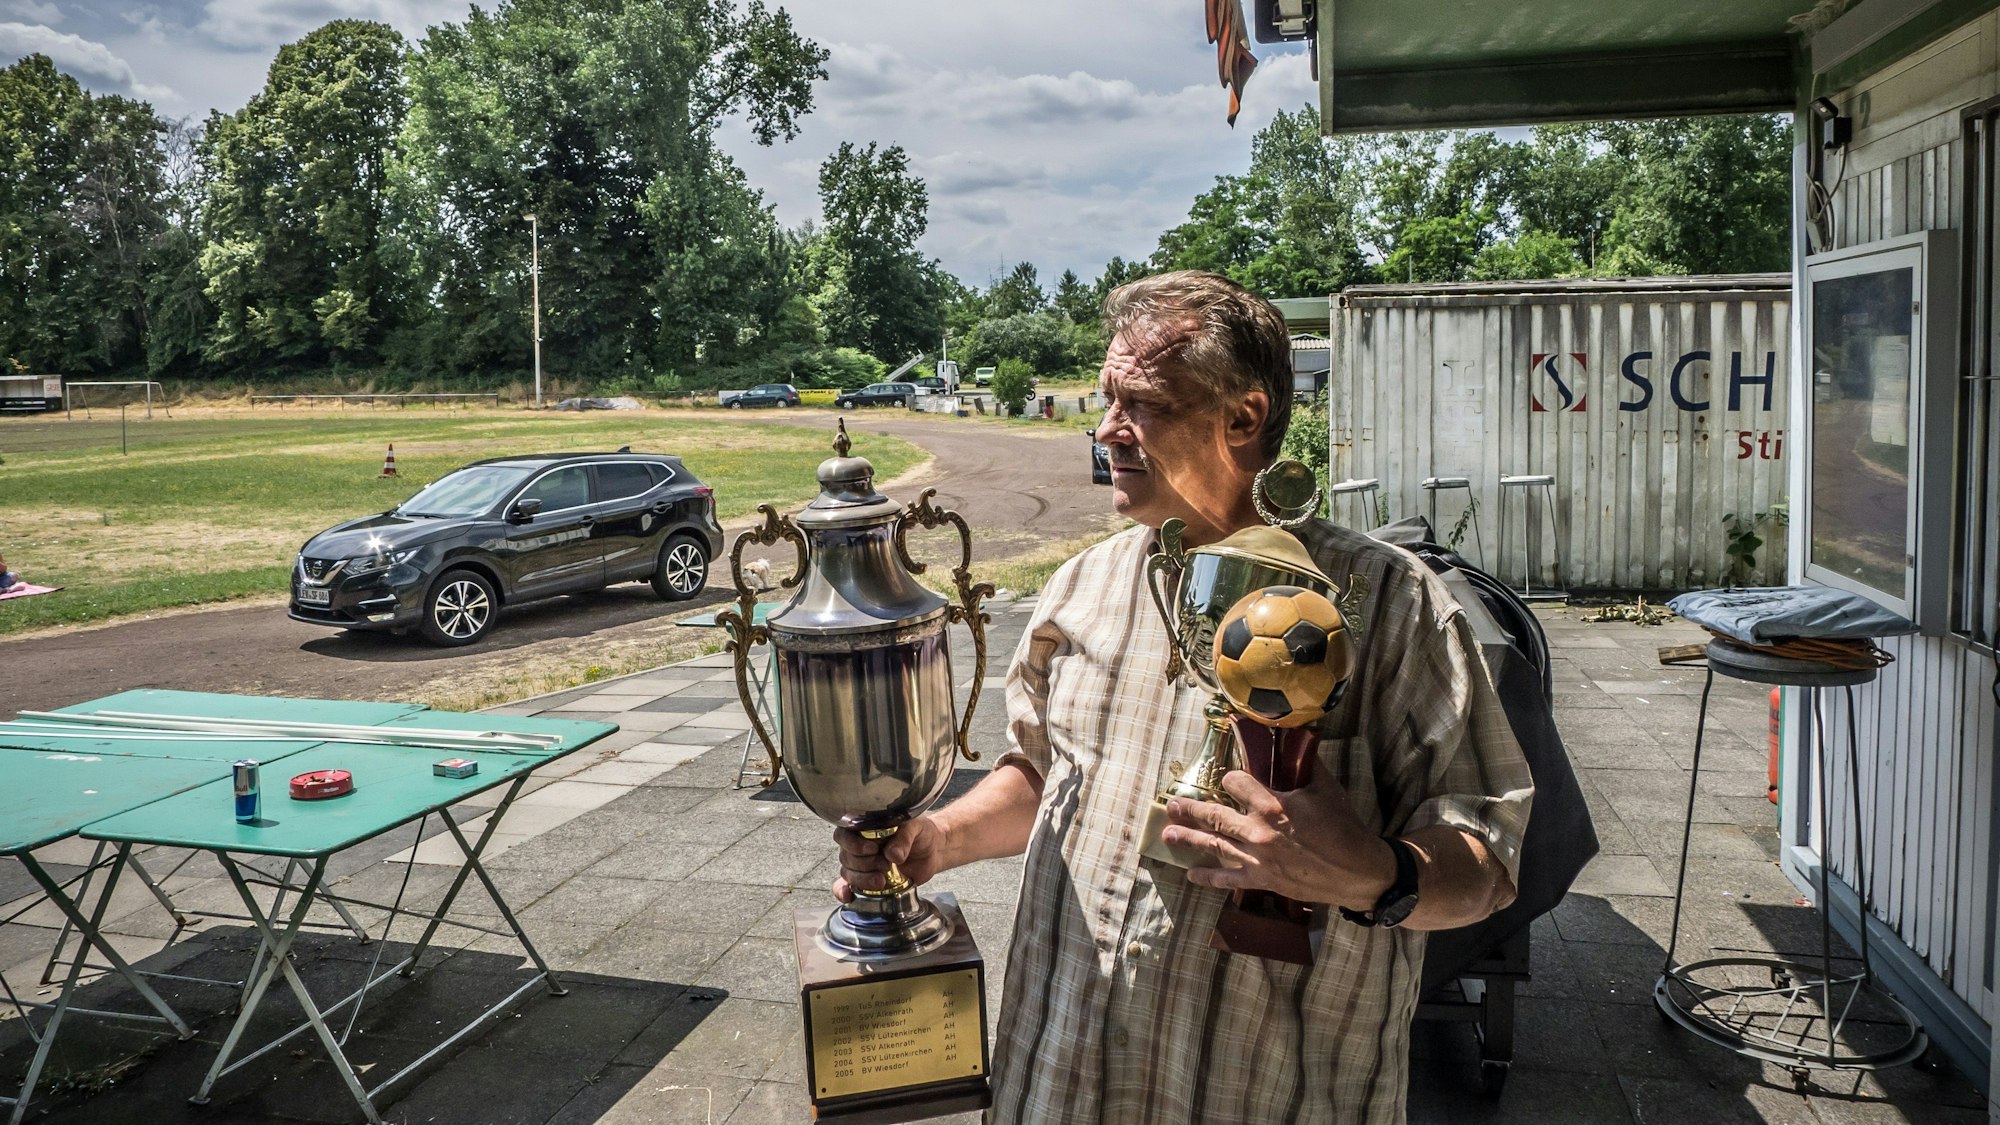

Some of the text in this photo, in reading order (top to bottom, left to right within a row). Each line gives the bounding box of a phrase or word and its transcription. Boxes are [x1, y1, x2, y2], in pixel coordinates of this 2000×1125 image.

[1619, 351, 1775, 412] SCH
[1737, 430, 1783, 460] Sti
[832, 1015, 851, 1024] 2000
[858, 1012, 874, 1021] SSV
[877, 1007, 914, 1018] Alkenrath
[833, 1004, 850, 1013] 1999
[875, 996, 912, 1007] Rheindorf
[833, 1037, 852, 1046] 2002
[860, 1034, 876, 1042] SSV
[944, 1022, 955, 1030] AH
[834, 1011, 955, 1035] 2001 BV Wiesdorf AH
[834, 1048, 853, 1057] 2003
[860, 1044, 876, 1053] SSV
[878, 1039, 915, 1050] Alkenrath
[834, 1059, 853, 1068] 2004
[861, 1055, 877, 1064] SSV
[945, 1043, 956, 1051] AH
[835, 1053, 957, 1078] 2005 BV Wiesdorf AH
